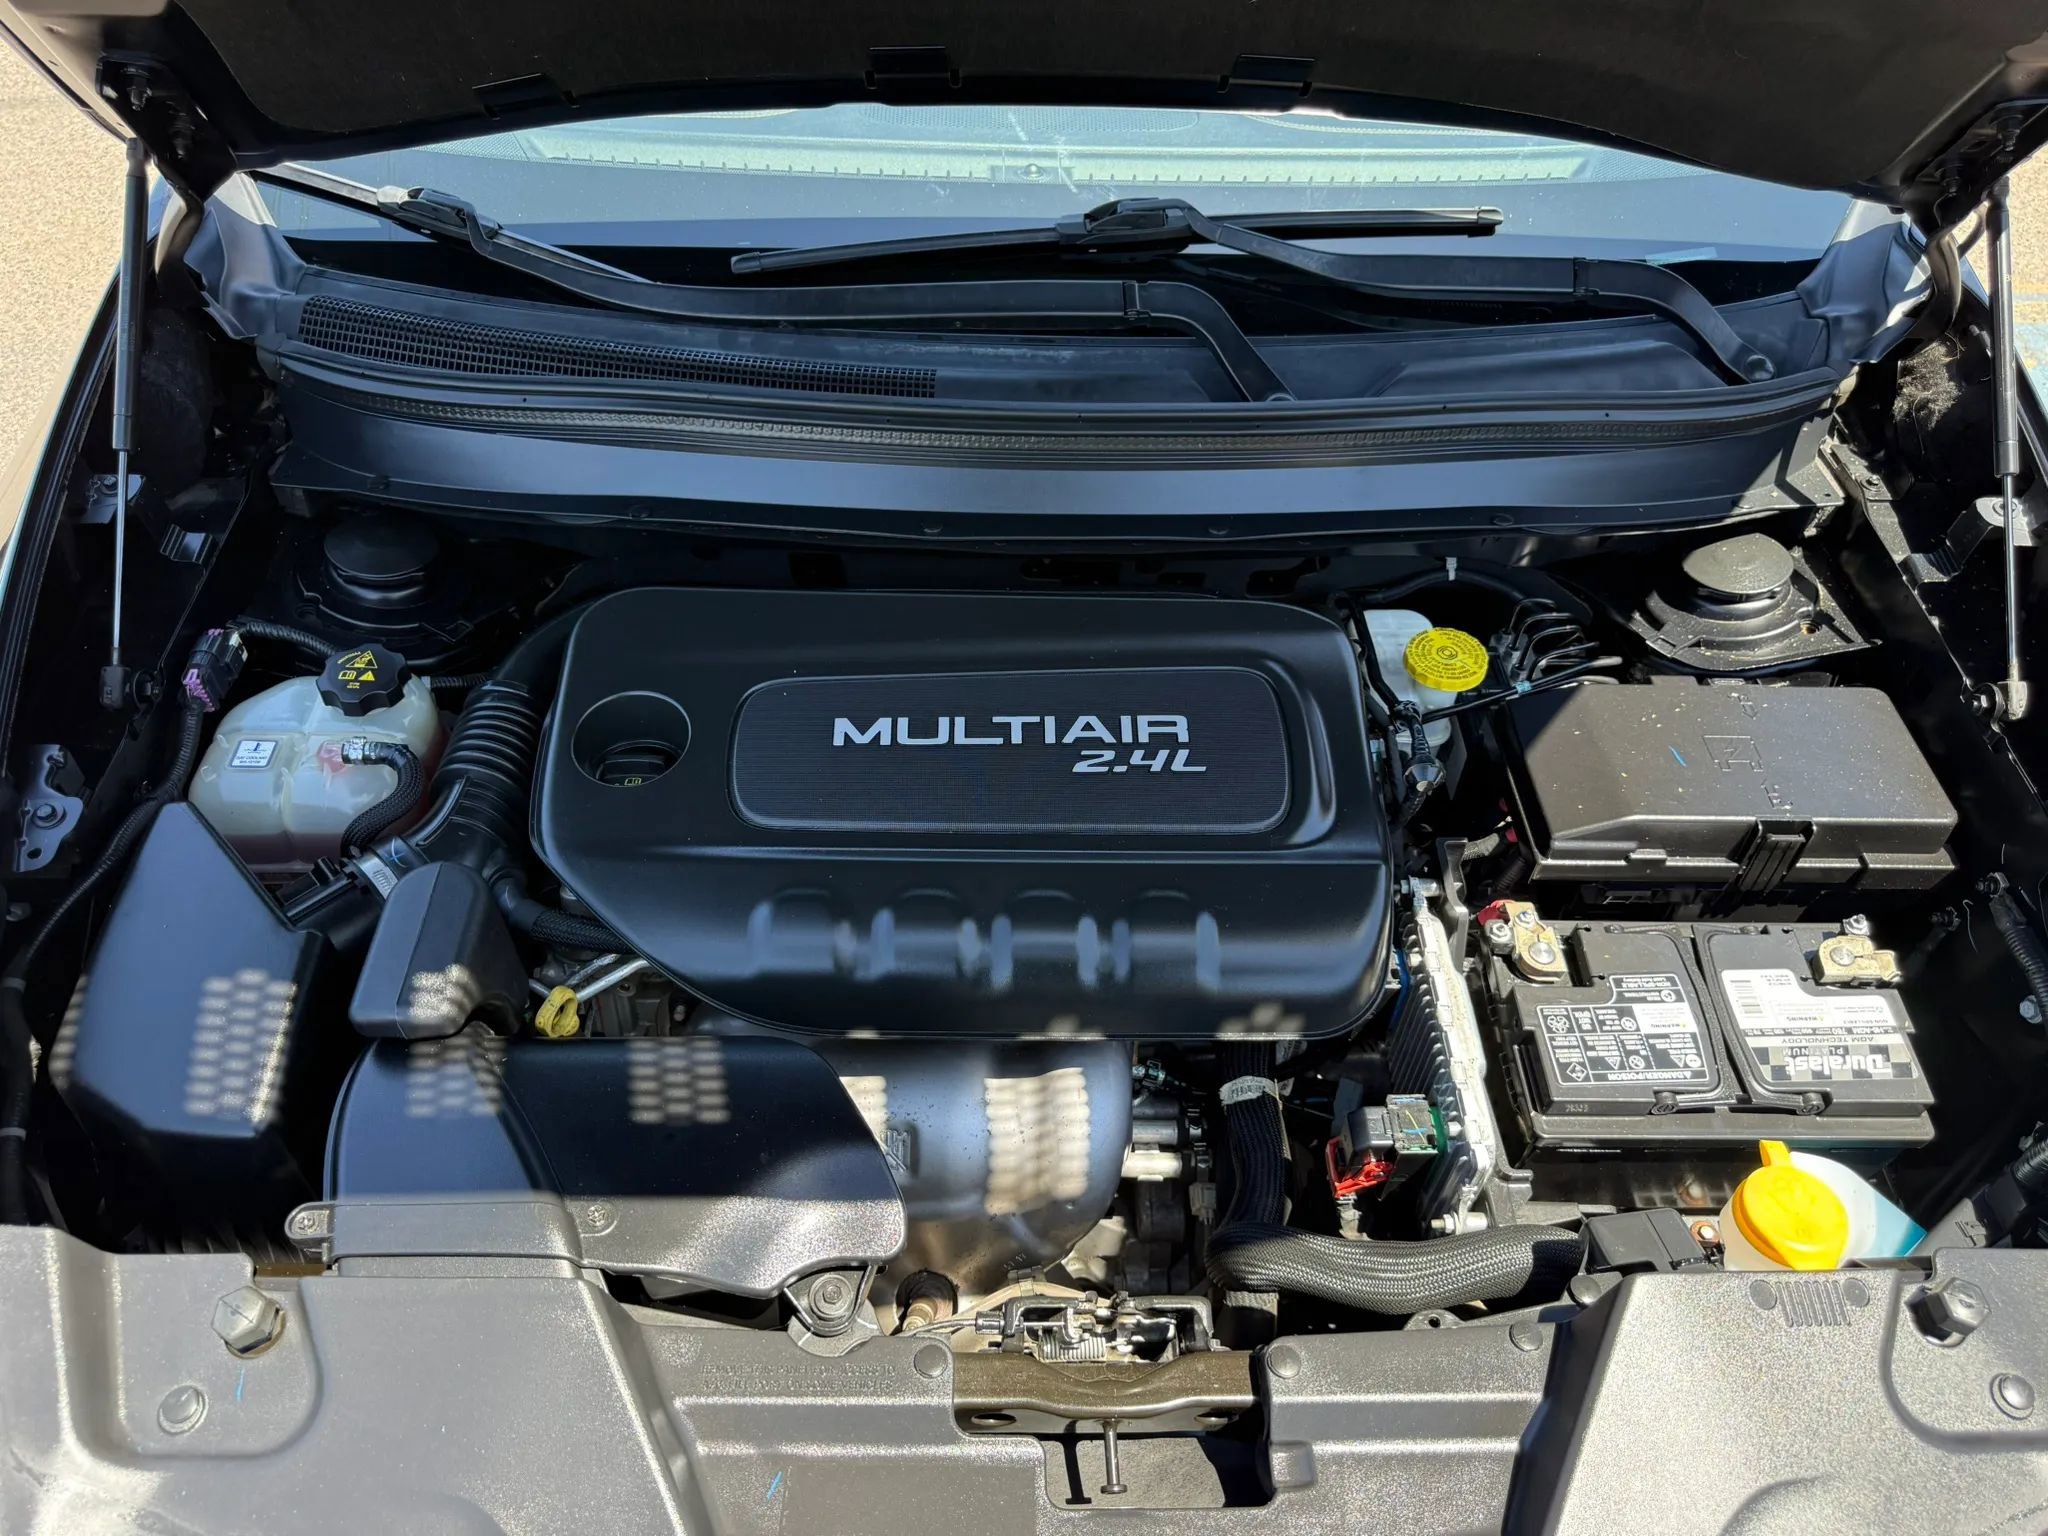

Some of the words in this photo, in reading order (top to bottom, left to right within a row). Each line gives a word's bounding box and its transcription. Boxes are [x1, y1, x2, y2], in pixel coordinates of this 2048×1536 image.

[832, 714, 1190, 746] MULTIAIR
[1071, 749, 1207, 773] 2.4L
[1783, 1047, 1844, 1056] PLATINUM
[1607, 1071, 1688, 1081] DANGER/POISON
[1785, 1053, 1892, 1076] Duralast
